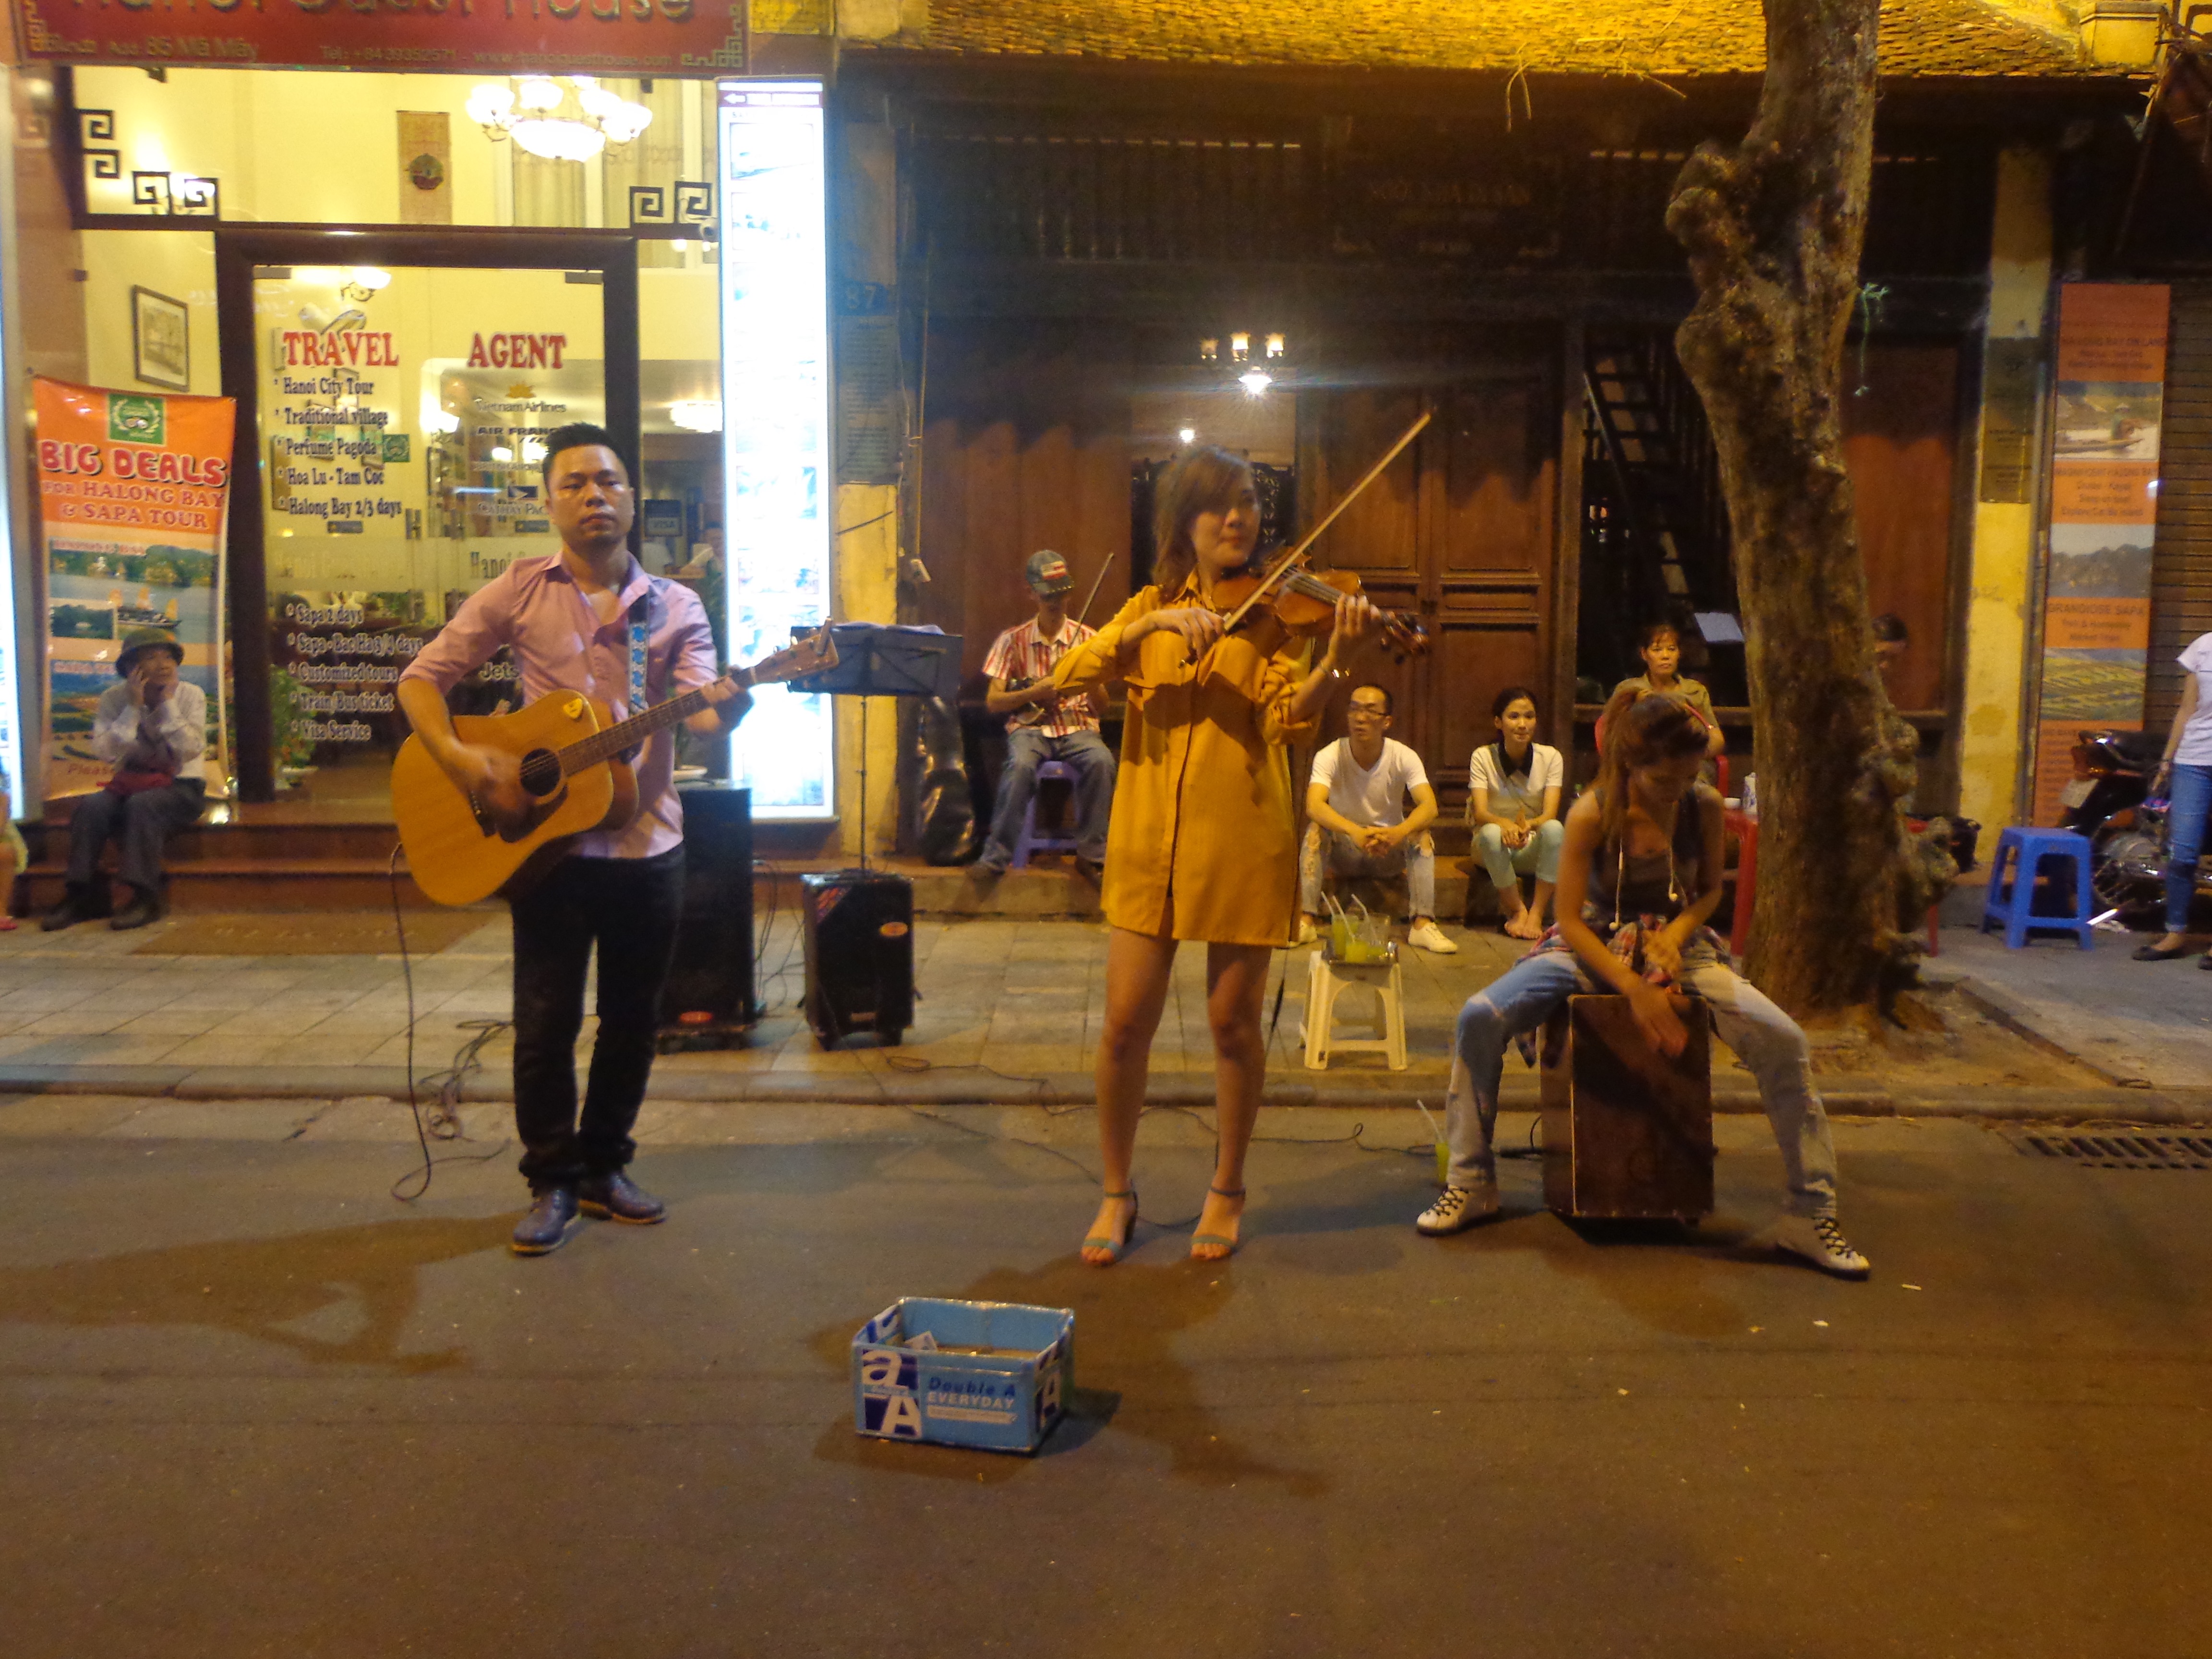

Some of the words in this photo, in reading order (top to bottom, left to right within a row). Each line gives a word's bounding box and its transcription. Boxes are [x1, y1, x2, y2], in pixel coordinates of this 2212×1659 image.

[283, 331, 399, 367] TRAVEL
[468, 332, 567, 369] AGENT
[283, 377, 316, 394] Hanoi
[320, 377, 342, 398] City
[347, 377, 374, 394] Tour
[525, 400, 566, 412] Airlines
[285, 407, 348, 424] Traditional
[352, 408, 388, 429] village
[286, 437, 334, 455] Perfume
[337, 437, 376, 459] Pagoda
[40, 439, 102, 475] BIG
[113, 448, 228, 488] DEALS
[288, 467, 309, 485] Hoa
[313, 467, 326, 485] Lu
[336, 467, 361, 485] Tam
[364, 467, 384, 485] Coc
[83, 481, 174, 505] HALONG
[181, 489, 225, 508] BAY
[84, 503, 142, 523] SAPA
[149, 509, 208, 528] TOUR
[289, 498, 328, 519] Halong
[331, 498, 352, 518] Bay
[356, 498, 373, 517] 2/3
[377, 498, 402, 518] days
[526, 503, 545, 514] PAC
[296, 603, 325, 628] Sapa
[337, 604, 364, 628] days
[2115, 603, 2144, 615] SAPA
[479, 661, 520, 681] Jets
[301, 720, 327, 741] Visa
[327, 719, 372, 742] Service
[928, 1376, 996, 1396] Double
[1004, 1383, 1016, 1397] A
[927, 1392, 1014, 1409] EVERYDAY
